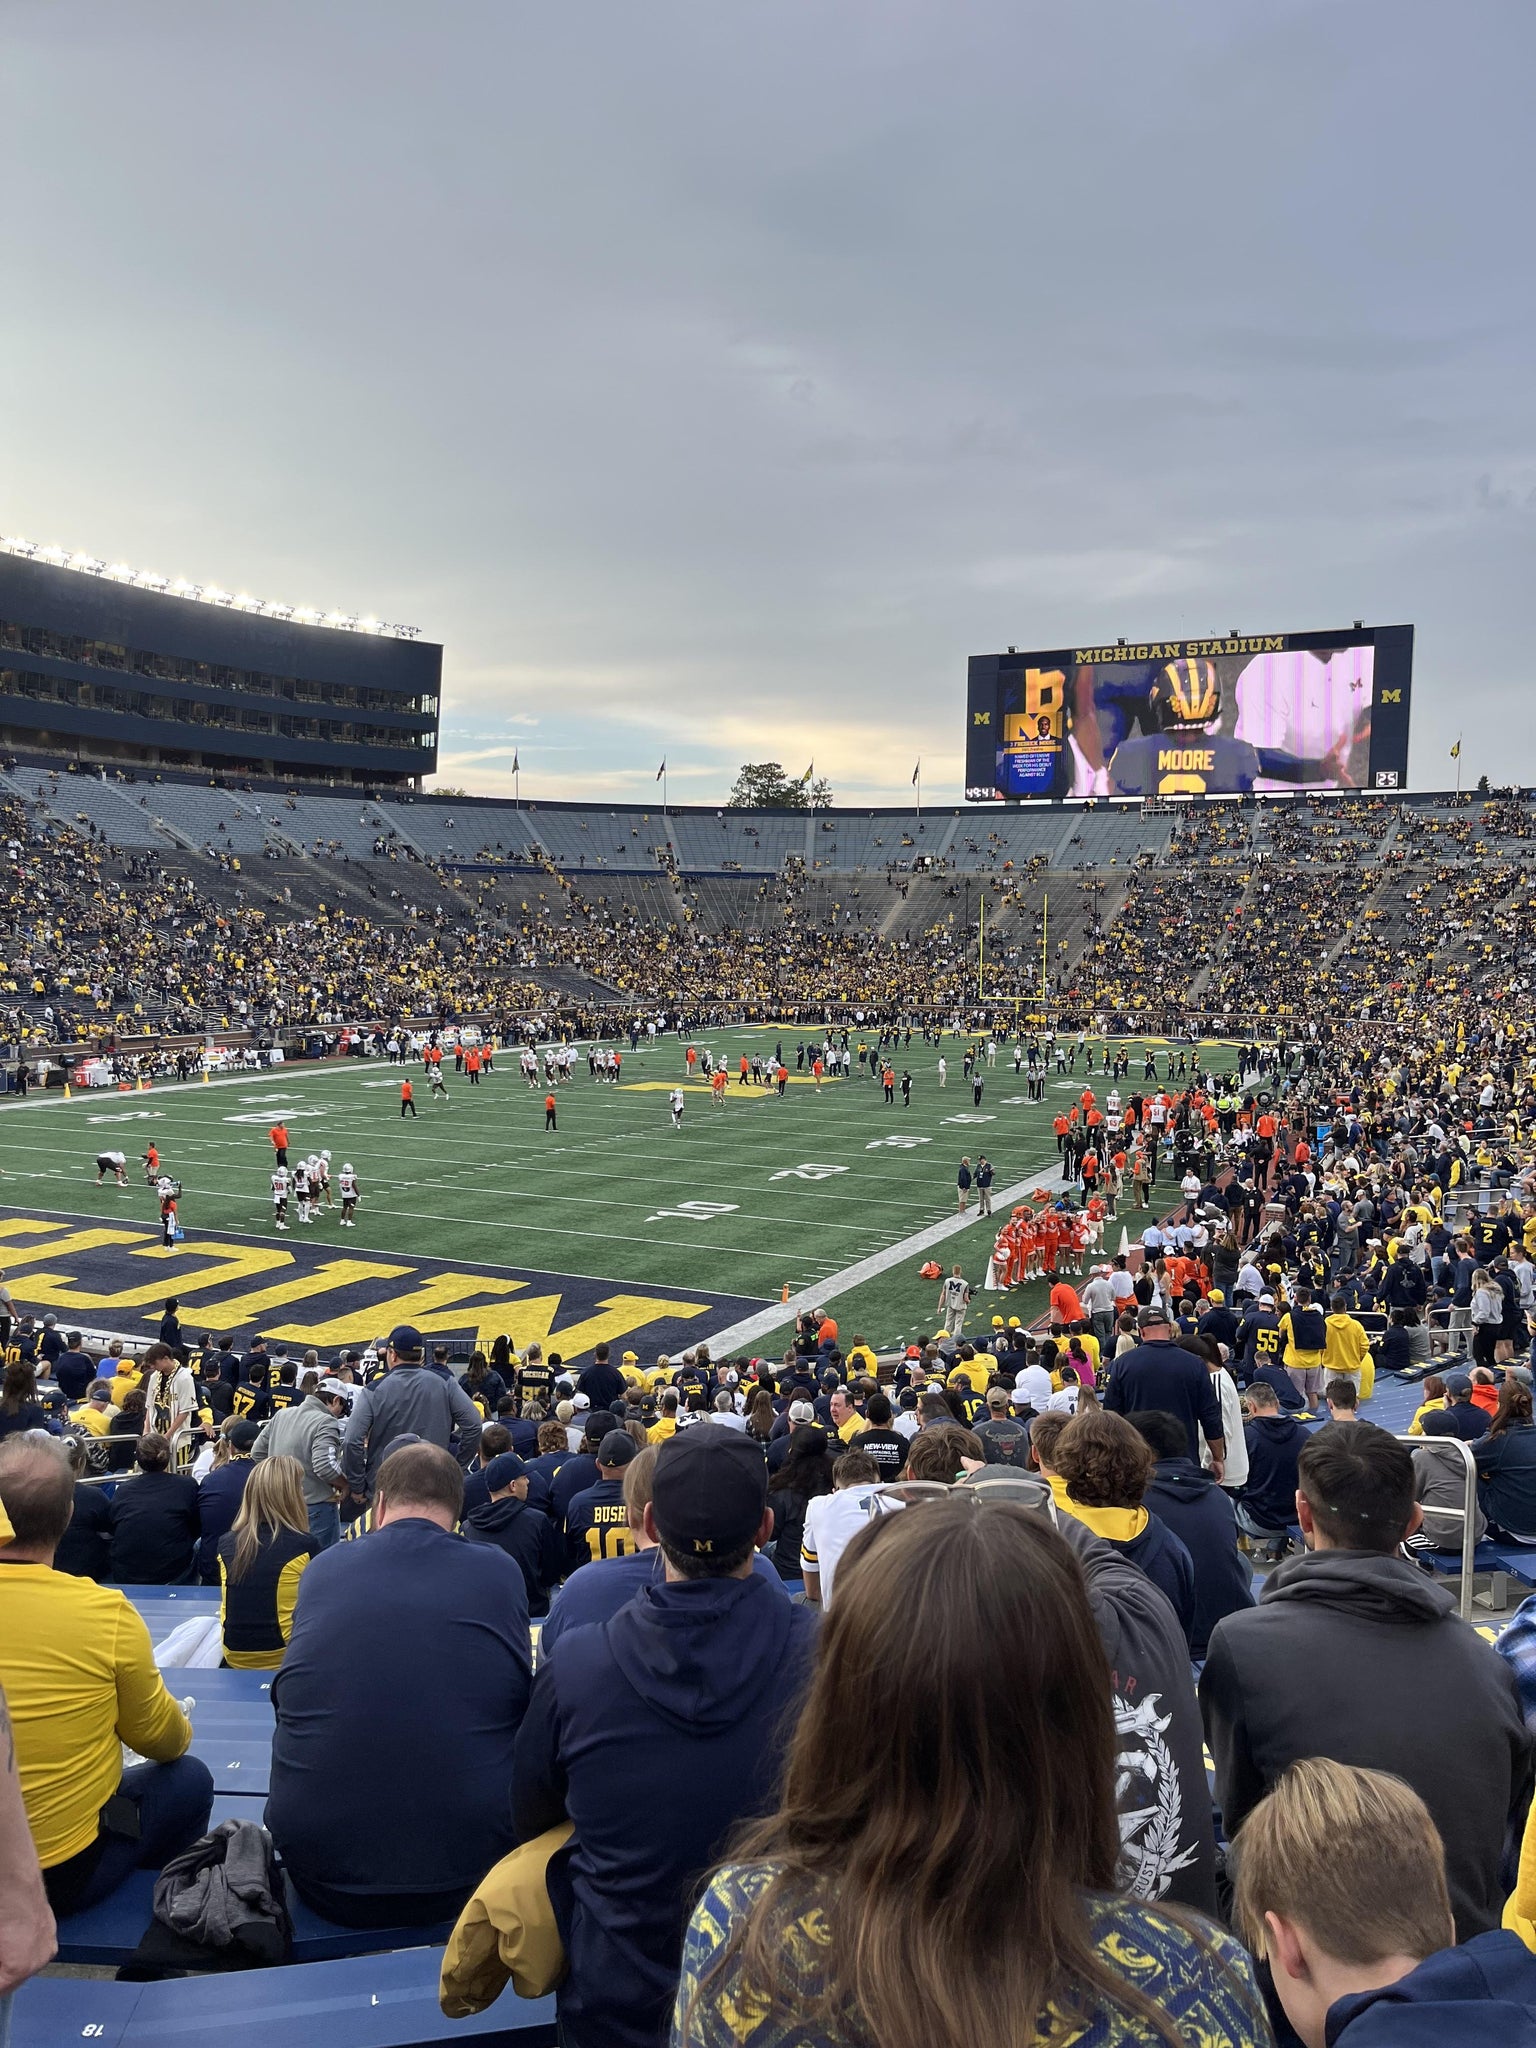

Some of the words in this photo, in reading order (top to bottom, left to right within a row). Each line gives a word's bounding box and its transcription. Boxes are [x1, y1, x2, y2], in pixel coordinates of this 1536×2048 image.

[1075, 643, 1181, 664] MICHIGAN
[1185, 636, 1284, 657] STADIUM
[1381, 689, 1401, 704] M
[974, 712, 990, 725] M
[1158, 749, 1216, 771] MOORE
[1378, 773, 1396, 786] 25
[966, 787, 996, 798] 49:41
[865, 1135, 933, 1150] 30
[768, 1163, 851, 1182] 20
[644, 1200, 741, 1223] 10
[1482, 1229, 1494, 1244] 2
[948, 1281, 962, 1293] M
[1256, 1328, 1279, 1353] 55
[44, 1401, 53, 1409] M
[233, 1391, 256, 1420] 97
[863, 1443, 899, 1451] NEW-VIEW
[593, 1505, 626, 1523] BUSH
[693, 1539, 713, 1553] M
[226, 1761, 241, 1769] 17
[370, 1994, 380, 2007] 1
[81, 2023, 105, 2038] 18
